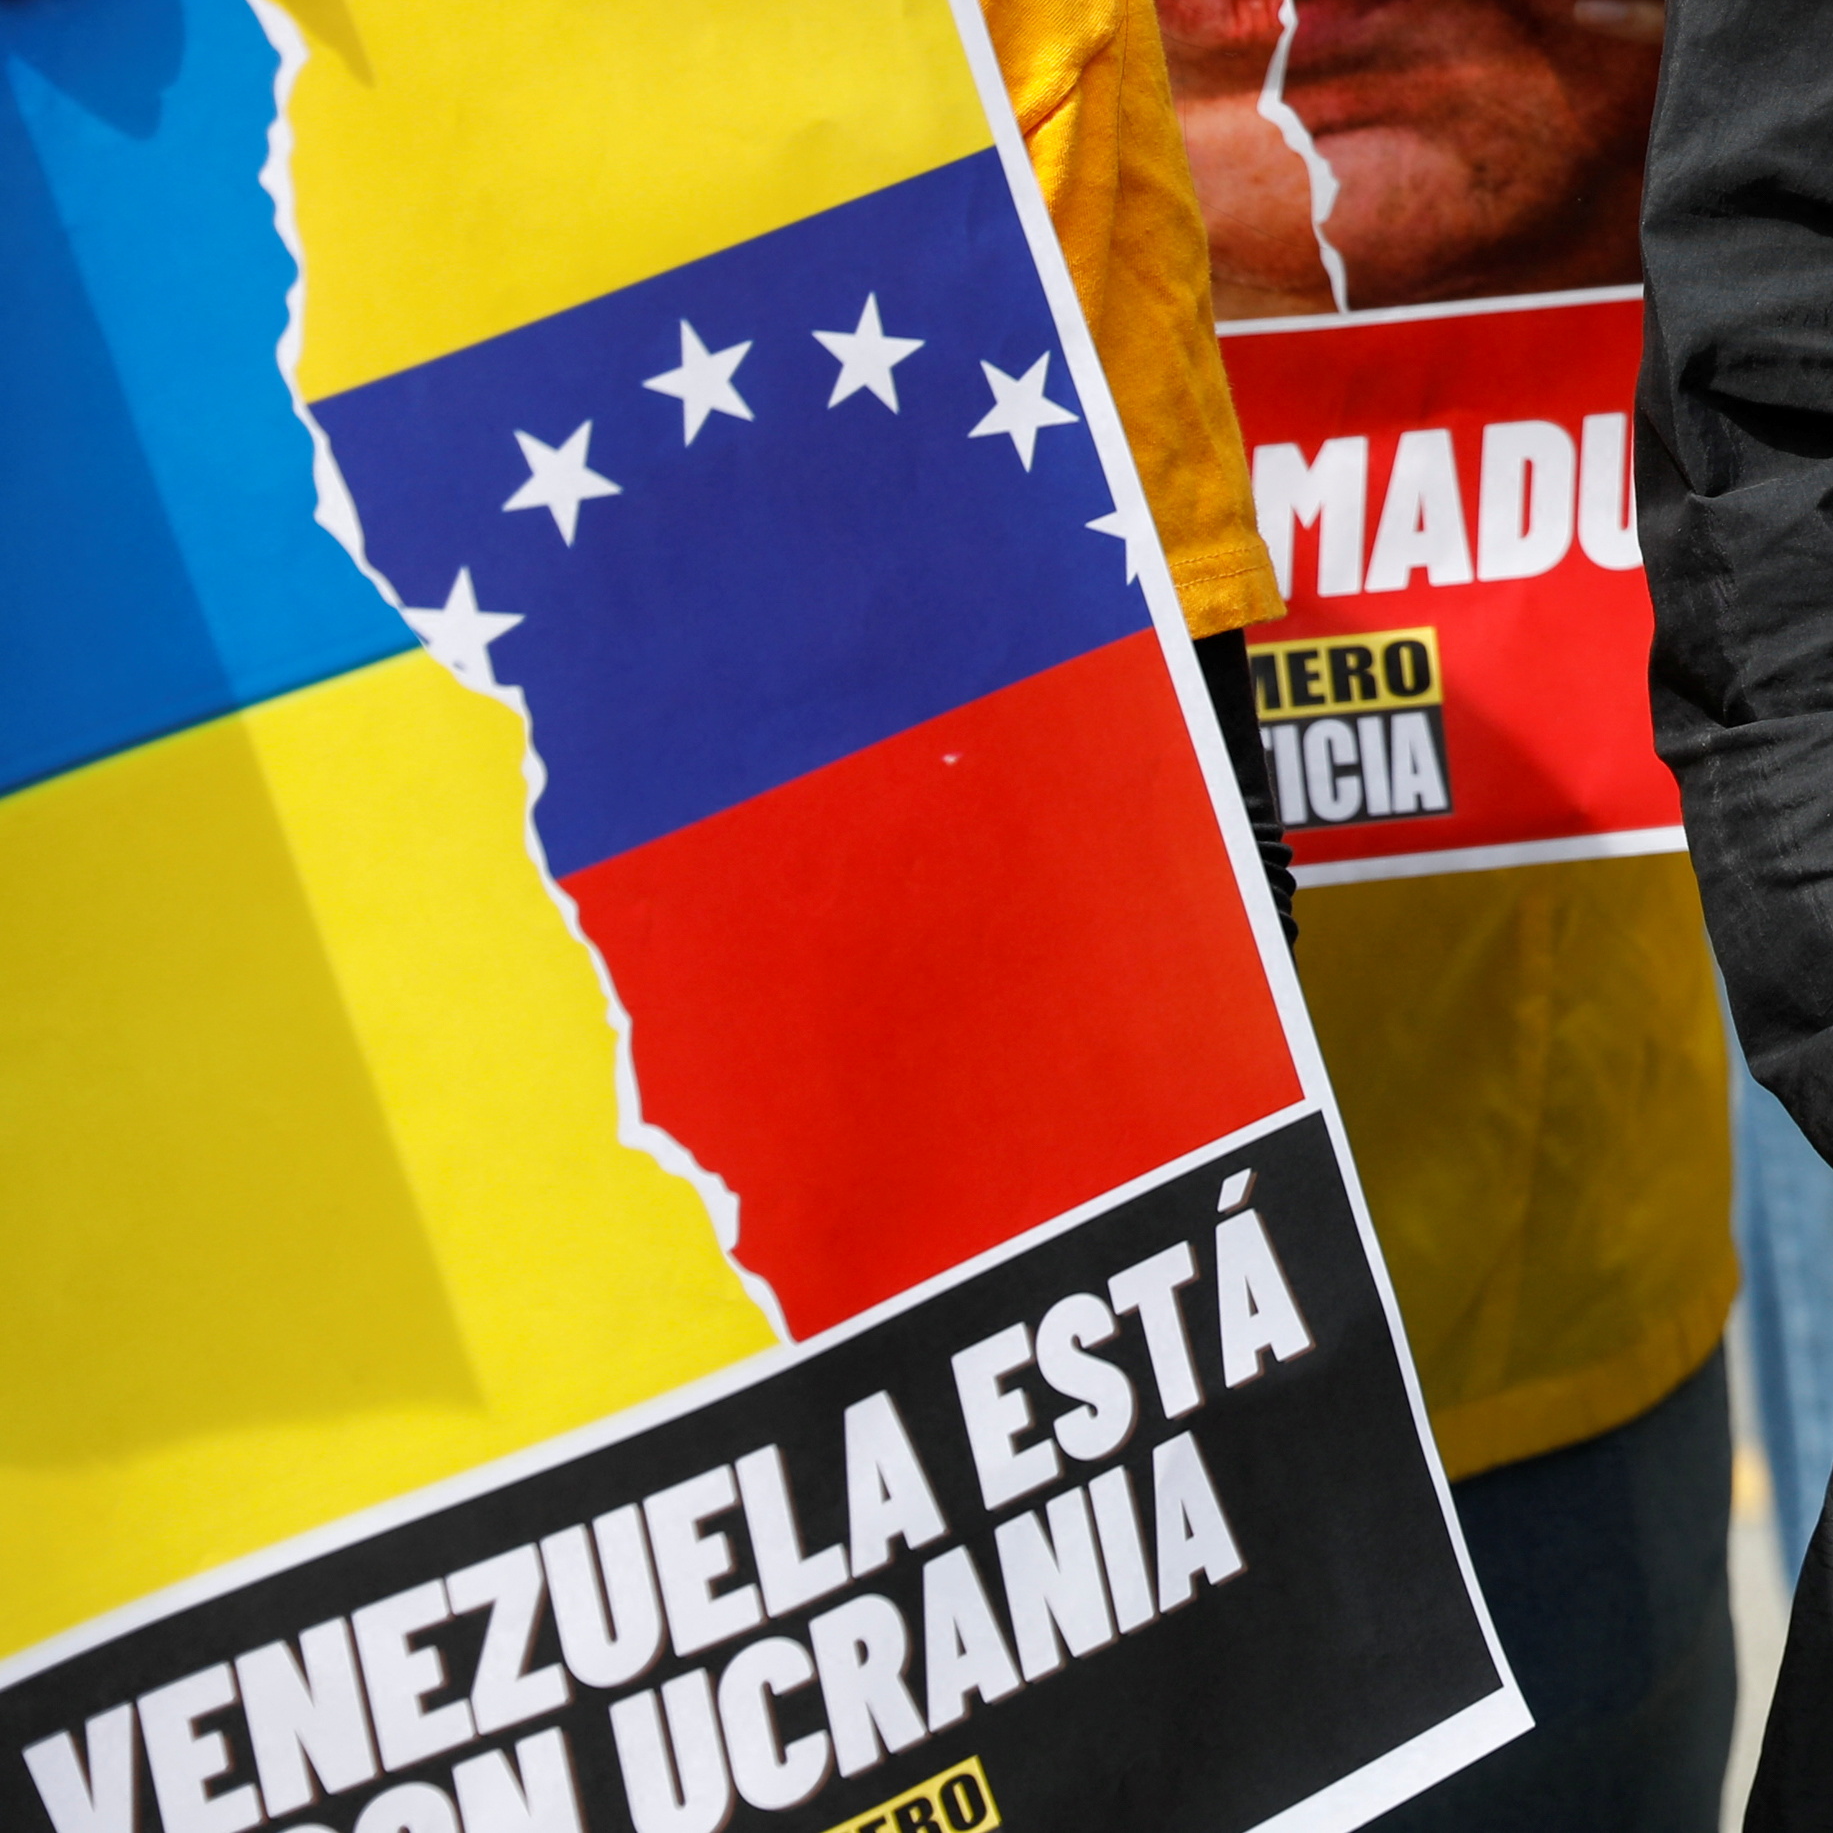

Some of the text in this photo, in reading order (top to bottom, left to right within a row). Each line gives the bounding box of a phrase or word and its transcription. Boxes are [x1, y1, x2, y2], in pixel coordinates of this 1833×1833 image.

[1260, 712, 1448, 826] ICIA
[22, 1168, 1316, 1833] VENEZUELA ESTÁ
[609, 1430, 1246, 1833] UCRANIA
